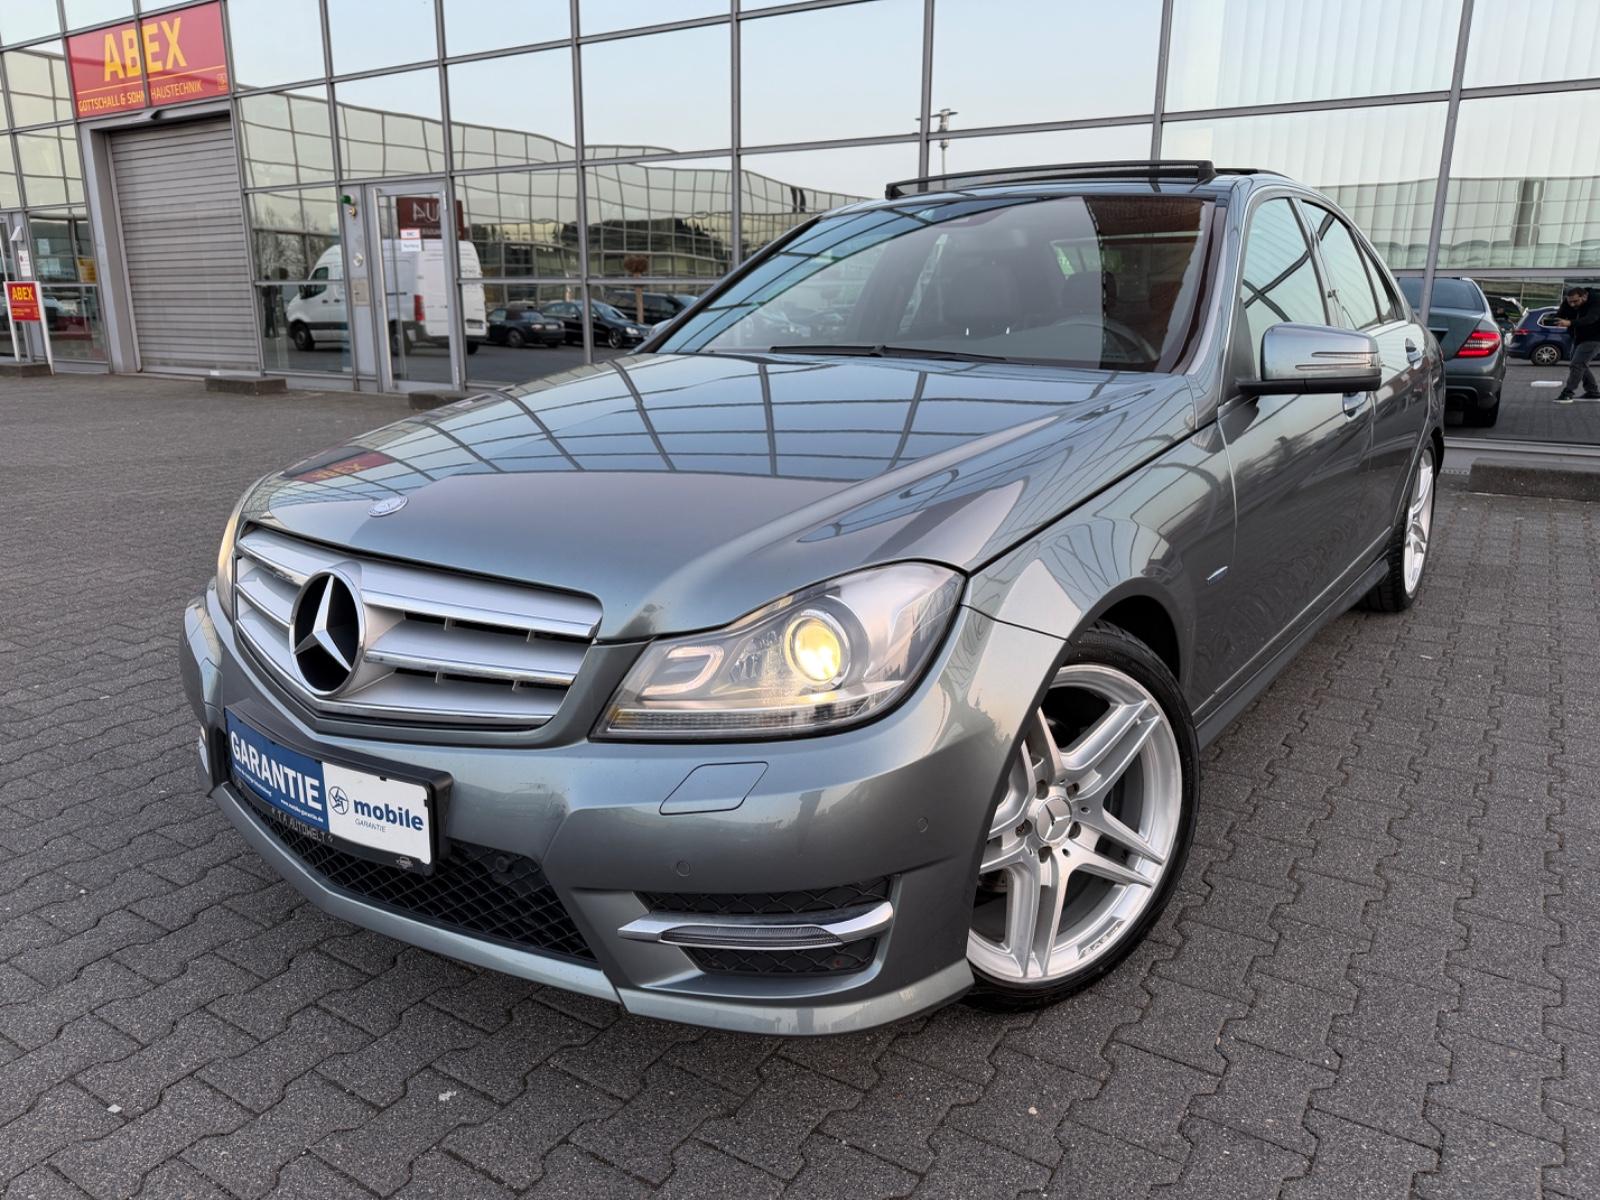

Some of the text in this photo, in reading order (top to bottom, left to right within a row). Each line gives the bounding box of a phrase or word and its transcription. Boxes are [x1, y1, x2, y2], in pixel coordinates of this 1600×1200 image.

[104, 17, 187, 82] ABEX
[78, 94, 120, 112] GOTTSCHALL
[120, 93, 126, 104] &
[151, 79, 202, 99] HAUSTECHNIK
[11, 286, 34, 301] ABEX
[231, 731, 322, 811] GARANTIE
[353, 799, 423, 831] mobile
[354, 818, 387, 833] GARANTIE
